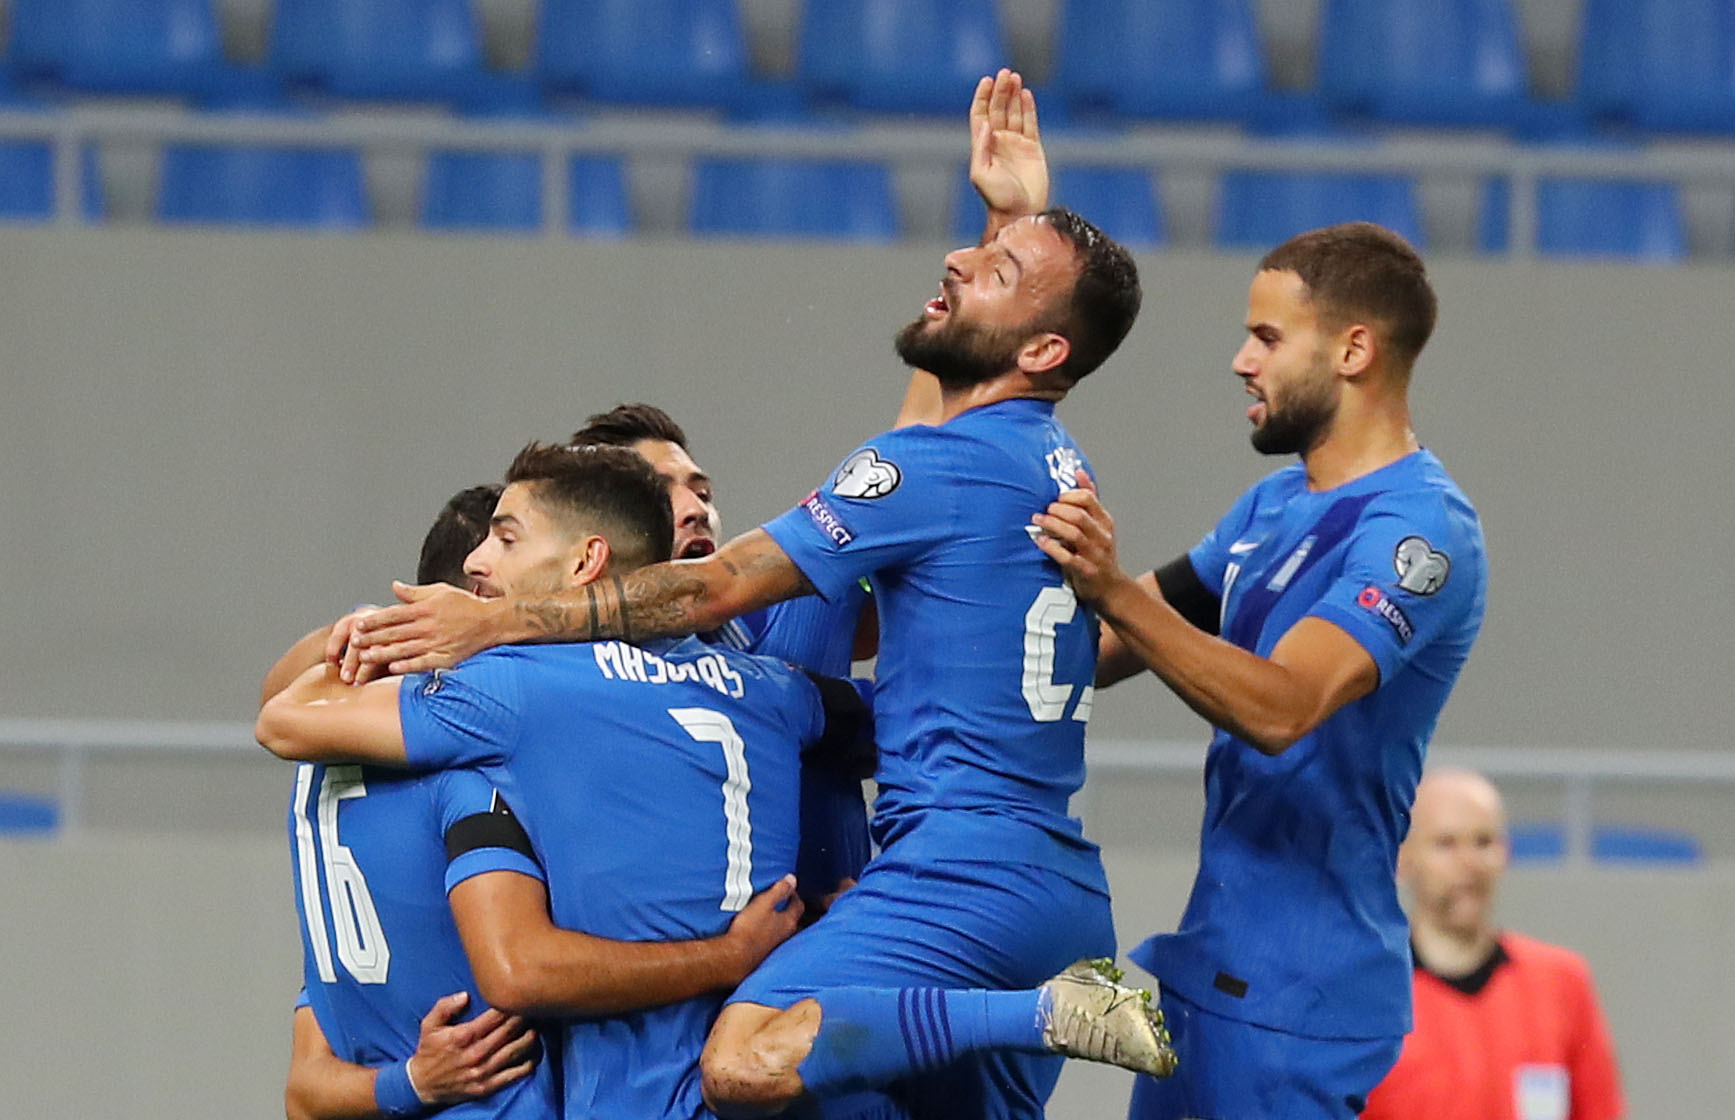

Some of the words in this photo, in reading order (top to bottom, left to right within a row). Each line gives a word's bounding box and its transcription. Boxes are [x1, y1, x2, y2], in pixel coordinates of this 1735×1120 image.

[807, 498, 852, 545] RESPECT
[1376, 598, 1413, 642] RESPEC
[667, 707, 753, 912] 7
[294, 763, 391, 984] 16
